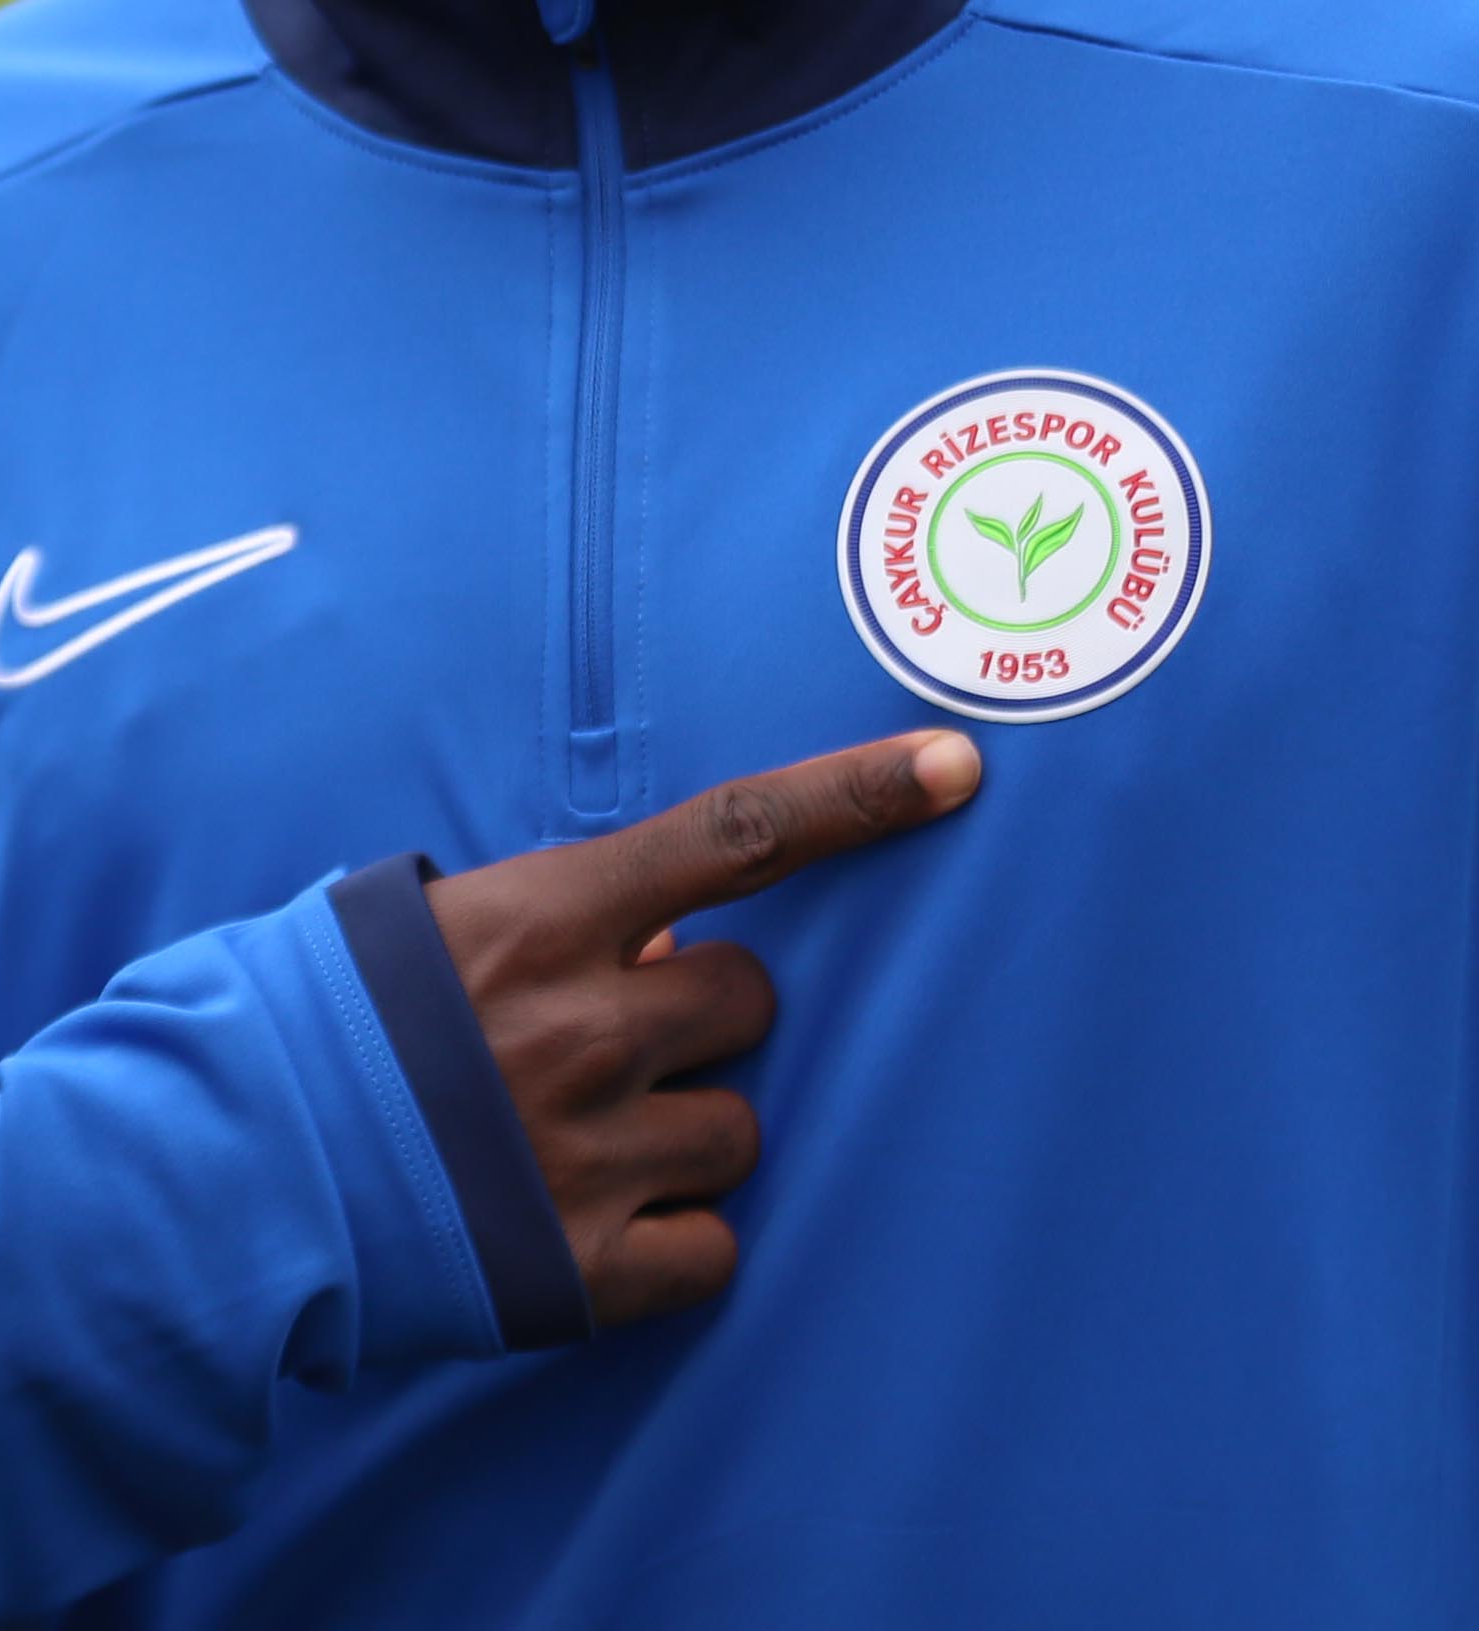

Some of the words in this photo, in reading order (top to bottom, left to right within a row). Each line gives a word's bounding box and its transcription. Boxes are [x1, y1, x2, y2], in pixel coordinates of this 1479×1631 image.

[883, 485, 948, 636] ÇAYKUR
[921, 411, 1122, 479] RİZESPOR
[1106, 469, 1171, 632] KULÜBÜ
[978, 647, 1070, 684] 1953
